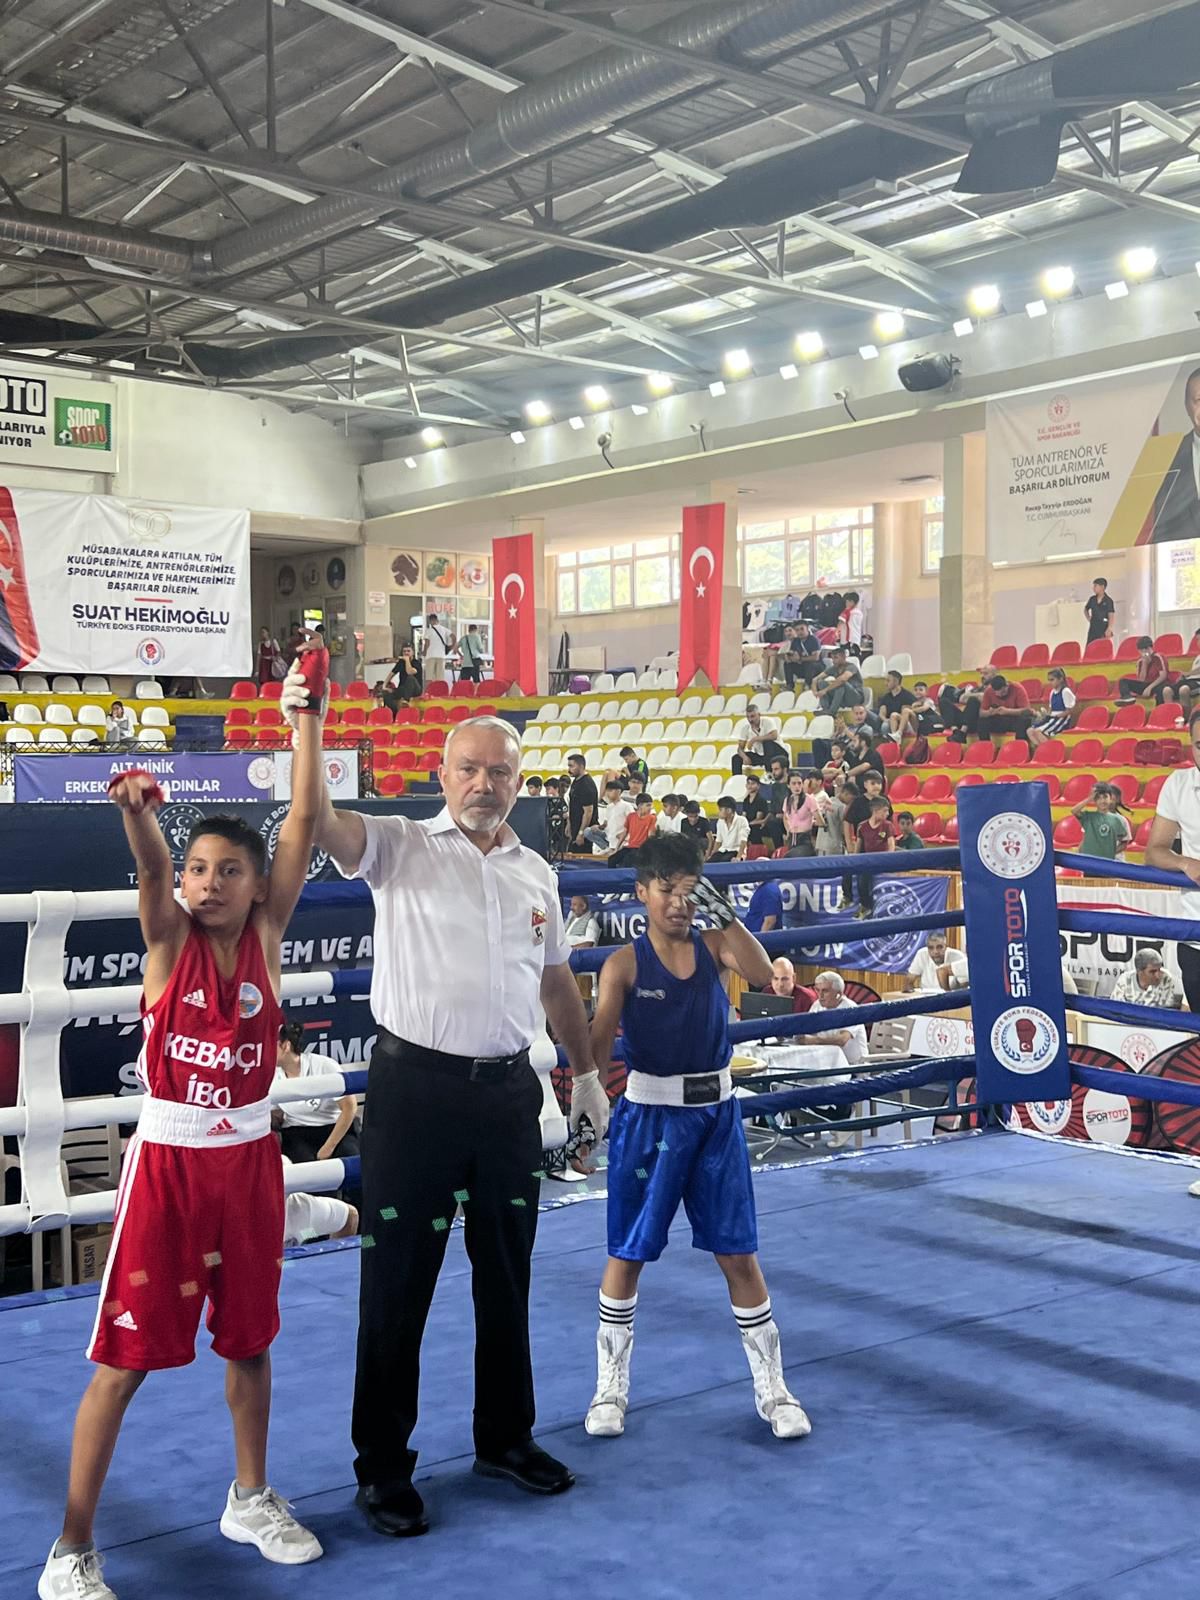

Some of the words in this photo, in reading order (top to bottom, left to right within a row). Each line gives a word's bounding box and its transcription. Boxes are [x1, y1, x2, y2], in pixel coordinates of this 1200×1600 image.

[1094, 443, 1109, 455] VE
[1014, 457, 1105, 482] SPORCULARIMIZA
[1009, 480, 1058, 495] BAŞARILAR
[1058, 471, 1110, 488] DİLİYORUM
[82, 544, 160, 558] MÜSABAKALARA
[67, 567, 150, 580] SPORCULARIMIZA
[152, 573, 164, 582] VE
[165, 574, 236, 586] HAKEMLERİMİZE
[107, 581, 160, 593] BAŞARILAR
[72, 603, 121, 620] SUAT
[125, 605, 230, 625] HEKİMOĞLU
[77, 620, 111, 629] TÜRKİYE
[135, 624, 193, 633] FEDERASYONU
[110, 762, 133, 775] ALT
[136, 758, 174, 774] MİNİK
[321, 936, 353, 962] VE
[185, 1073, 232, 1109] İBO
